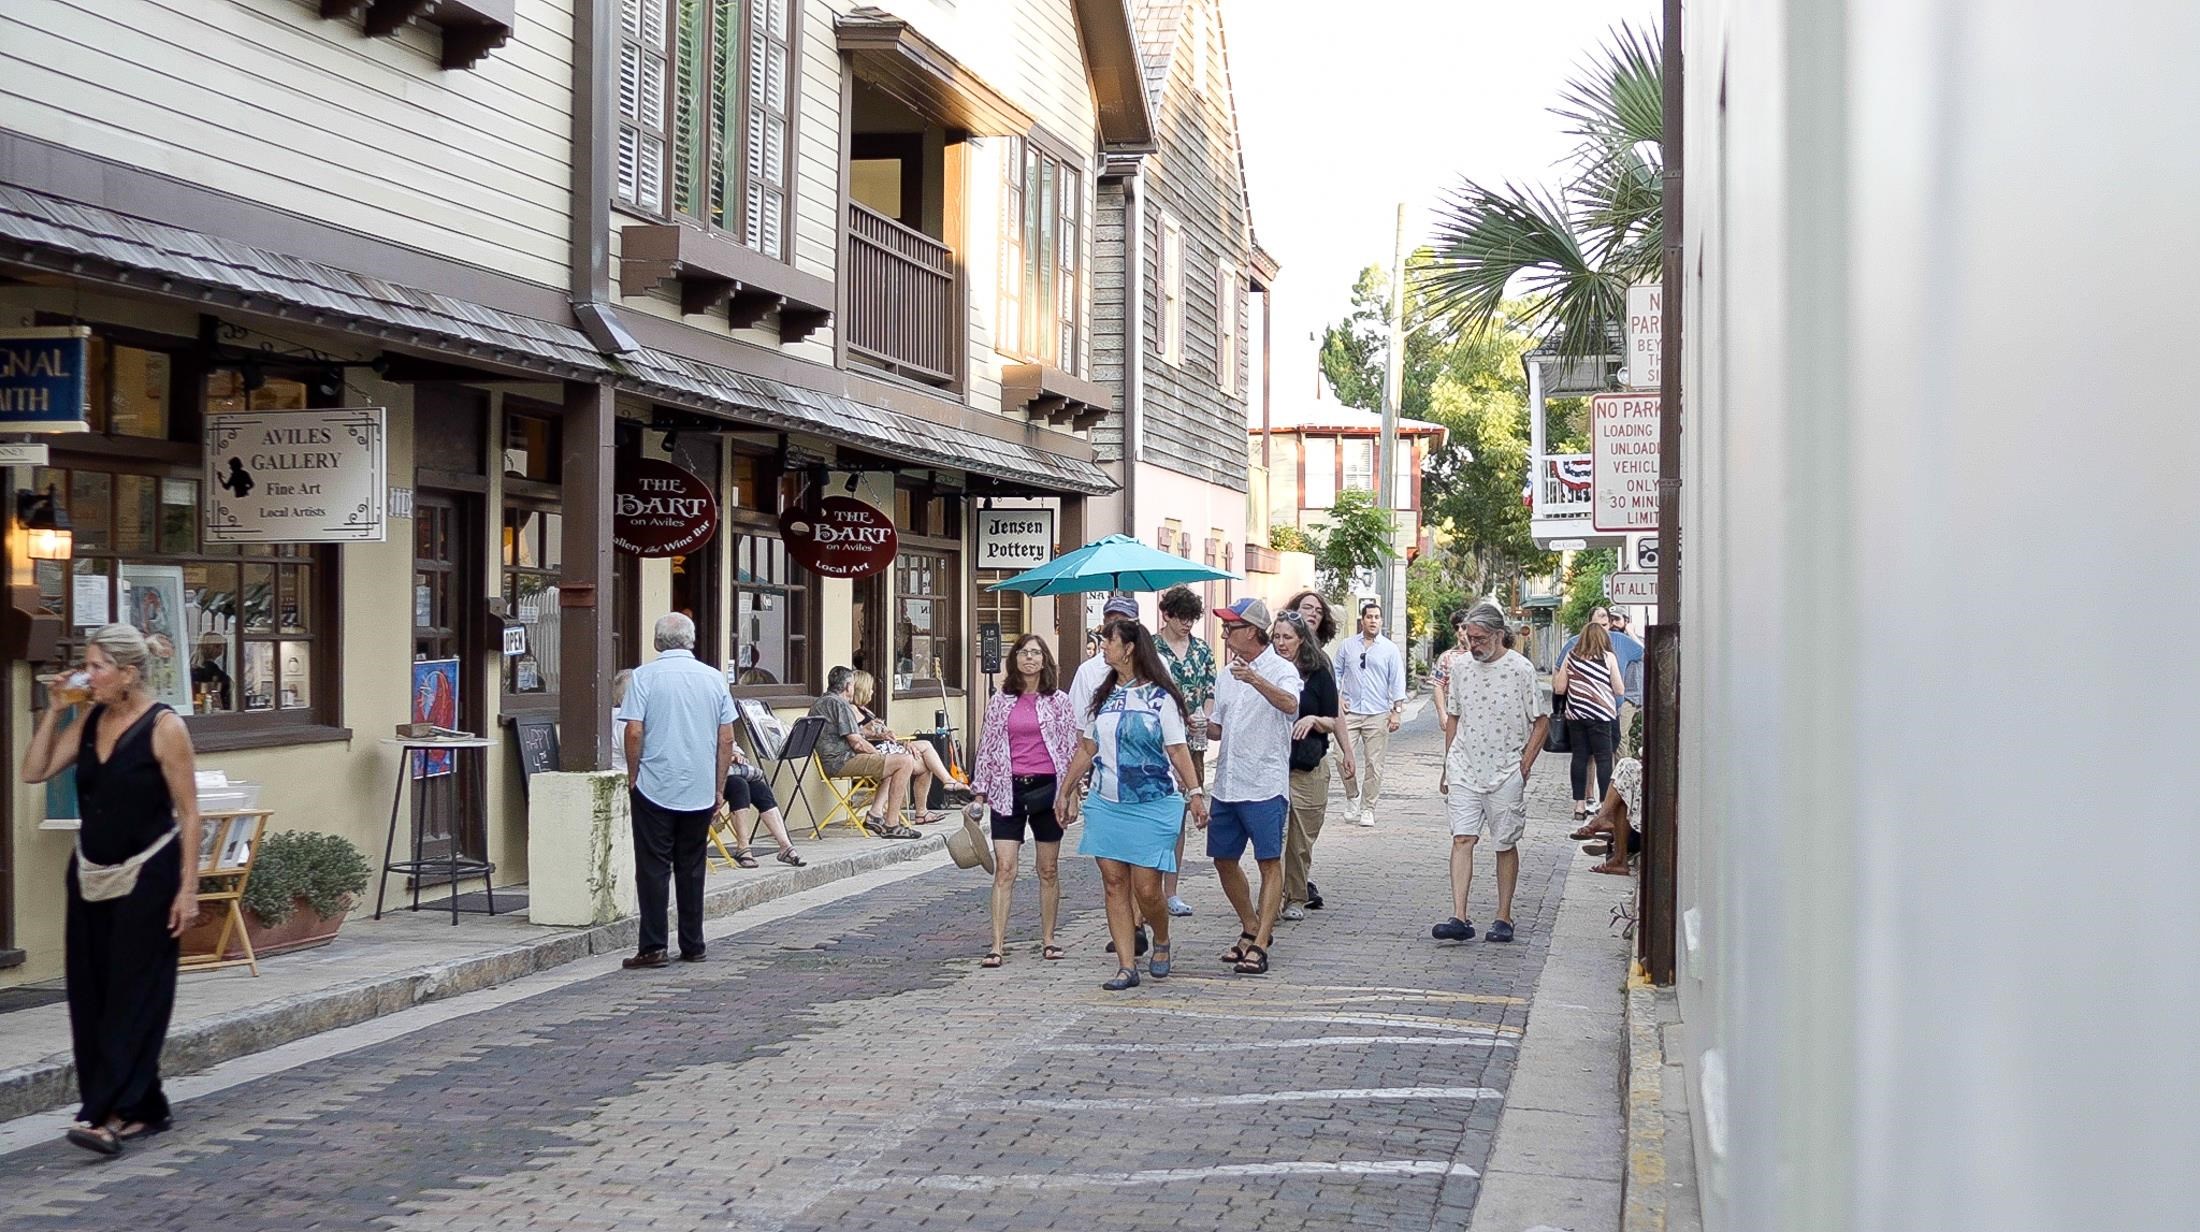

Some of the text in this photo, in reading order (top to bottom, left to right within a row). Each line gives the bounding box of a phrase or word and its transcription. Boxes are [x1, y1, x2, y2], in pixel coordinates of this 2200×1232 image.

[0, 387, 49, 411] ITH
[1597, 402, 1618, 418] NO
[262, 427, 331, 445] AVILES
[1604, 424, 1653, 437] LOADING
[251, 452, 342, 470] GALLERY
[1613, 460, 1658, 473] VEHICL
[266, 482, 321, 496] Fine Art
[639, 478, 687, 493] THE
[1626, 479, 1660, 492] ONLY
[615, 493, 707, 518] BART
[1610, 495, 1626, 508] 30
[259, 507, 326, 518] Local Artists
[834, 510, 874, 524] THE
[649, 517, 685, 527] Aviles
[989, 519, 1043, 535] Jensen
[613, 536, 642, 554] allery
[663, 535, 694, 552] Wine
[691, 520, 710, 537] Bar
[813, 523, 891, 545] BART
[841, 543, 872, 552] Aviles
[987, 542, 1044, 561] Pottery
[815, 560, 870, 573] Local Art
[1615, 582, 1625, 595] AT
[1629, 582, 1647, 595] ALL
[505, 630, 524, 653] OPEN
